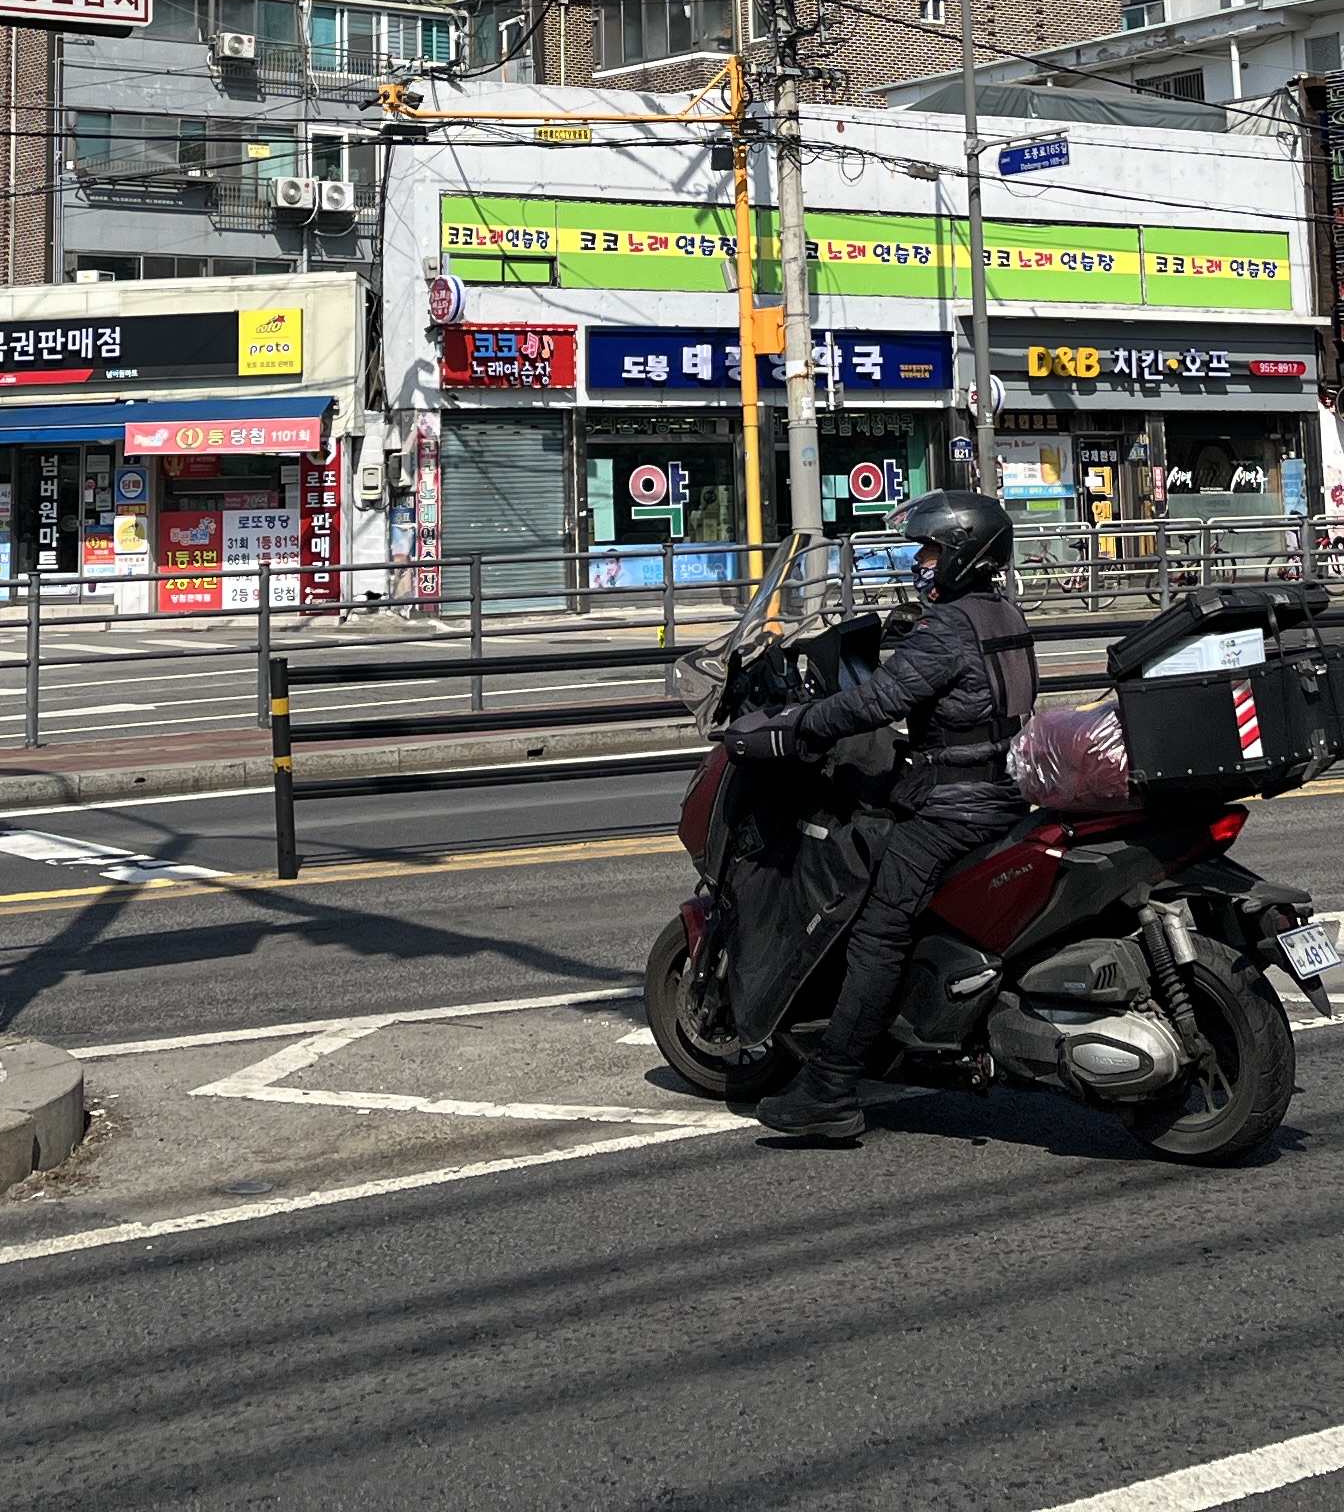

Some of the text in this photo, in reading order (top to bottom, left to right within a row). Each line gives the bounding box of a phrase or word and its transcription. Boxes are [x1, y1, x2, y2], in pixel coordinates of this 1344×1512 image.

[580, 231, 737, 257] 코코 노래 연습장
[828, 242, 867, 260] 노래
[872, 244, 932, 266] 연습장
[1018, 252, 1052, 268] 노래
[1060, 252, 1115, 272] 연습장
[1156, 256, 1278, 279] 코코 노래 연습장
[249, 342, 290, 355] proto
[473, 332, 519, 358] 코코
[622, 355, 669, 381] 도봉
[1028, 346, 1100, 377] D&B
[1259, 362, 1298, 374] 955-8917
[472, 360, 552, 386] 노래연습장
[230, 427, 266, 446] 당첨
[271, 429, 310, 443] 1101회
[954, 448, 969, 458] 821
[306, 470, 337, 487] 로또
[306, 491, 337, 508] 토토
[628, 461, 689, 539] 약
[849, 459, 903, 522] 약
[37, 455, 59, 569] 넘버원마트
[238, 514, 291, 529] 로또명당
[227, 537, 249, 549] 31회
[256, 536, 272, 549] 1등
[166, 550, 218, 569] 1등 3번
[227, 552, 250, 565] 66회
[232, 588, 248, 602] 2등
[273, 587, 296, 602] 당첨
[1305, 941, 1337, 967] 4811
